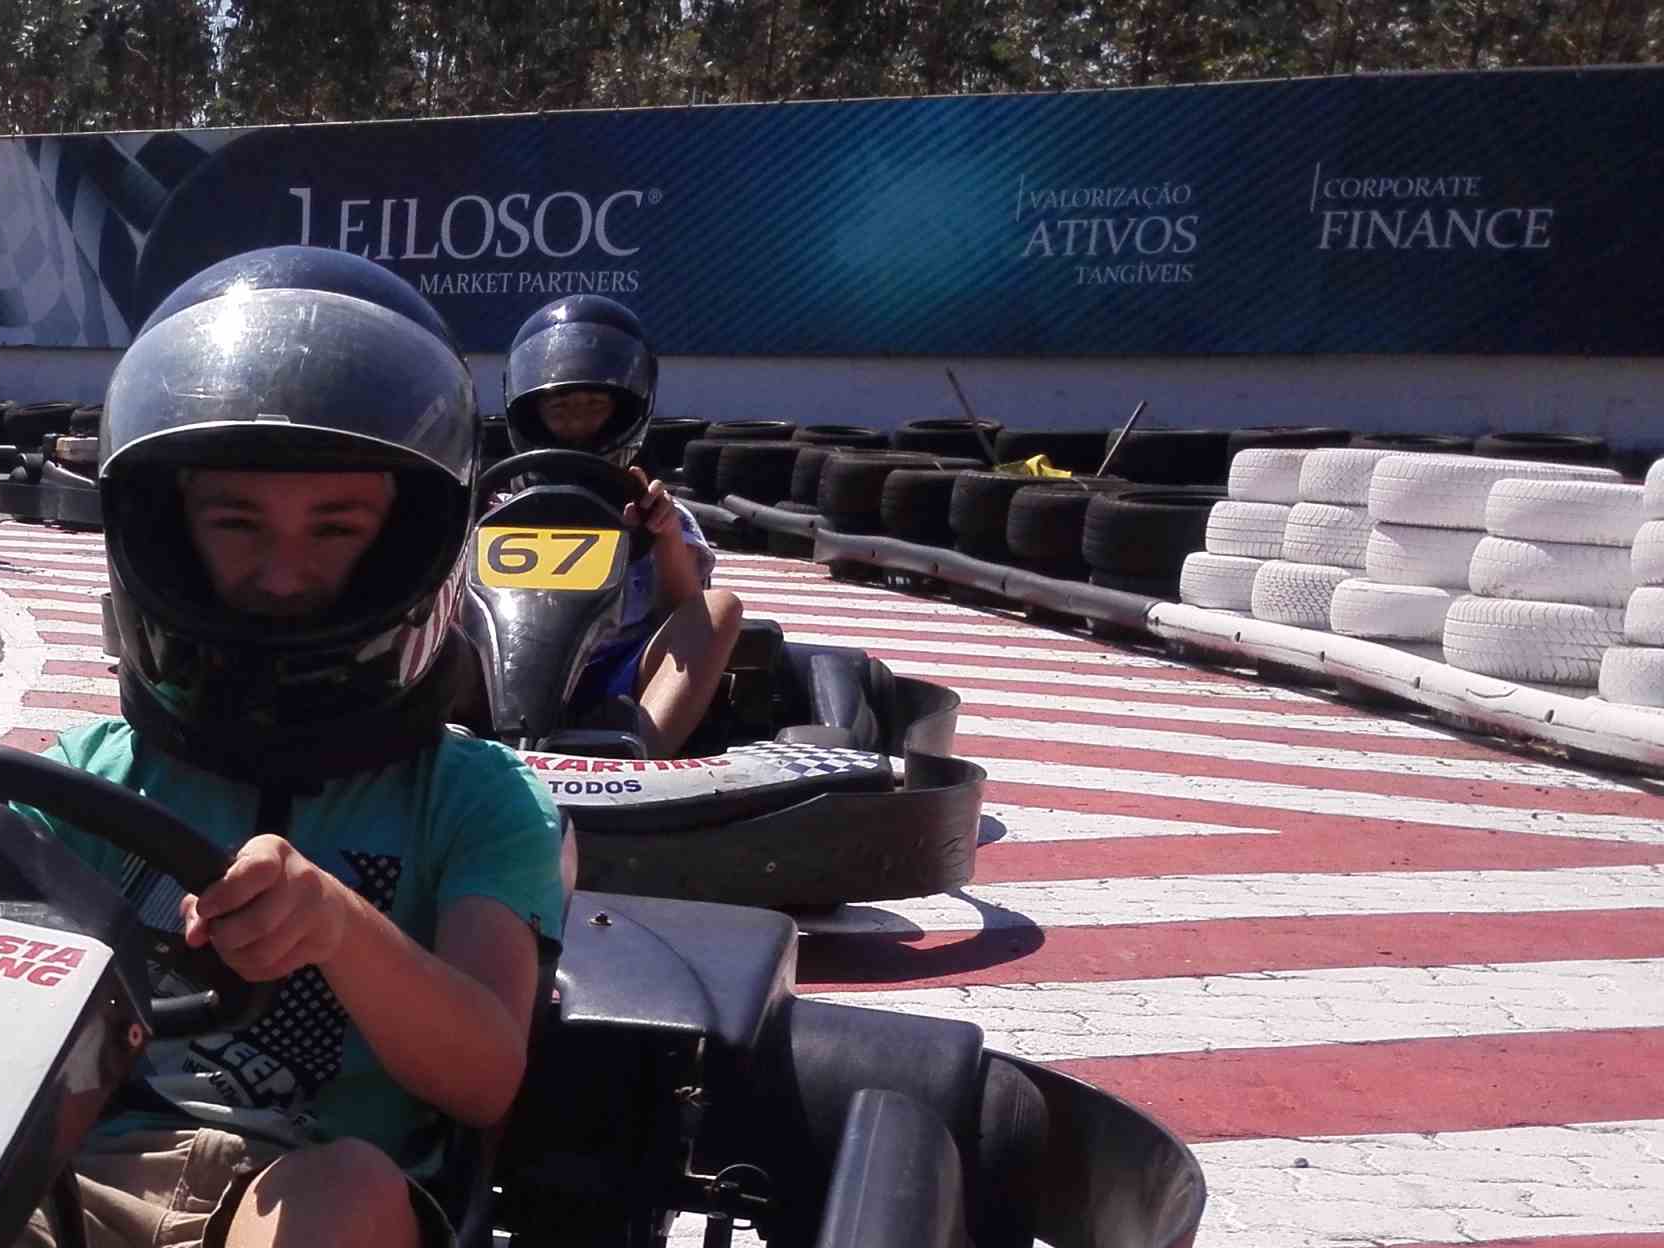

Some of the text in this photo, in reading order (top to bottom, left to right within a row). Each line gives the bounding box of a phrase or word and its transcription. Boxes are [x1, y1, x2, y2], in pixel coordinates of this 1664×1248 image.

[1030, 182, 1193, 209] VALORIZAÇÃO
[1323, 175, 1482, 199] CORPORATE
[1020, 215, 1201, 257] ATIVOS
[1317, 208, 1554, 250] FINANCE
[419, 269, 640, 295] MARKET PARTNERS
[1075, 260, 1195, 286] TANGÍVEIS
[487, 533, 600, 576] 67
[548, 780, 643, 795] TODOS
